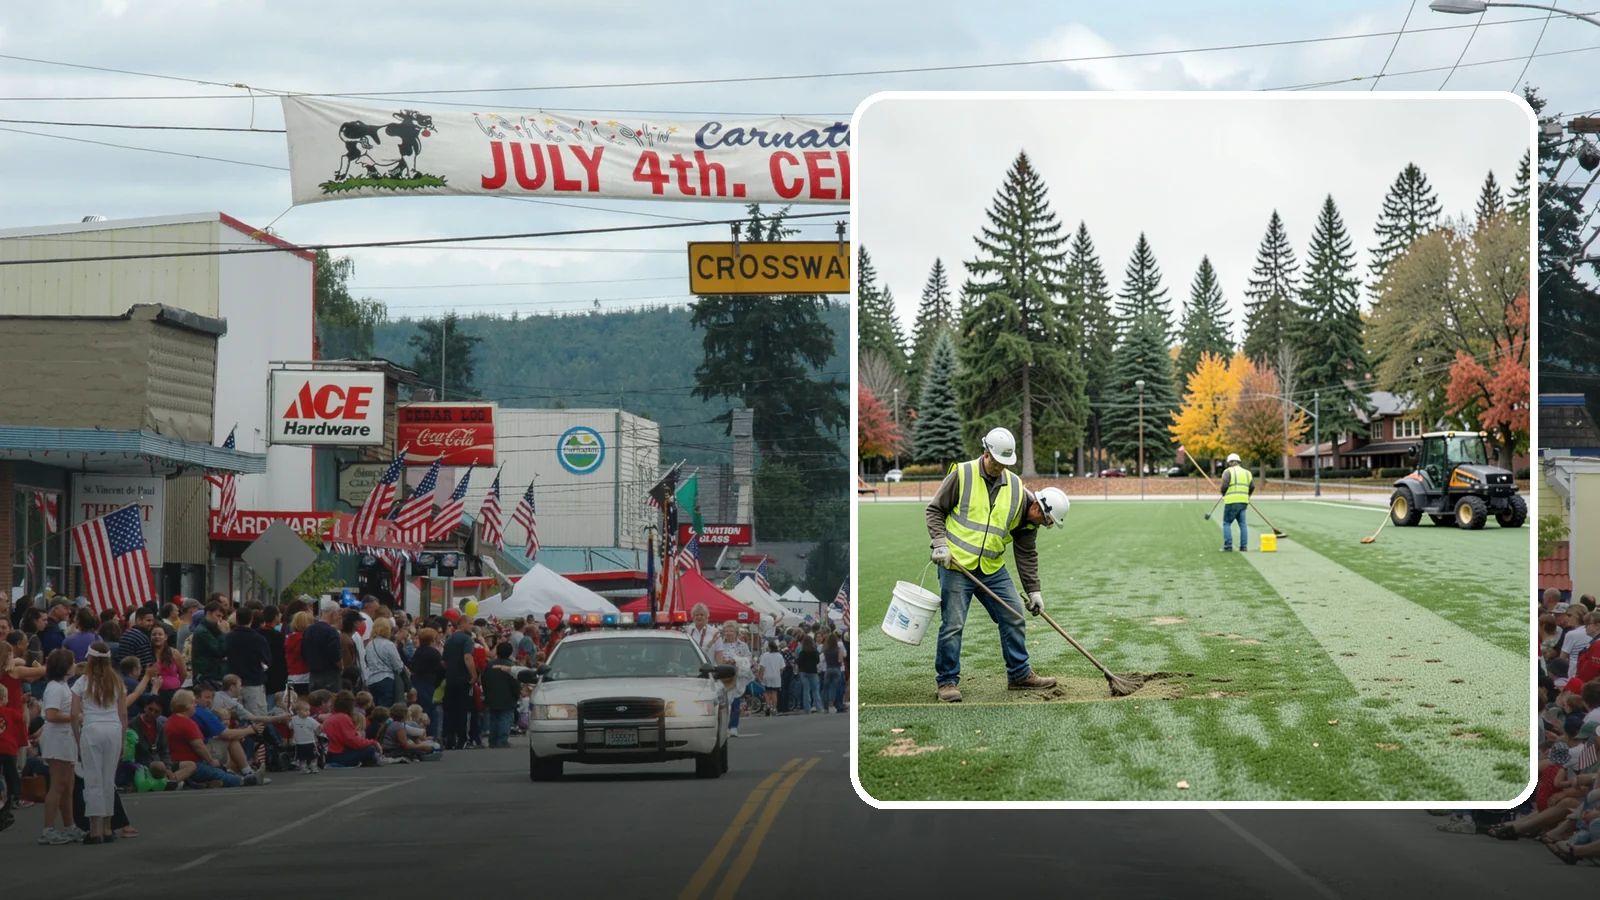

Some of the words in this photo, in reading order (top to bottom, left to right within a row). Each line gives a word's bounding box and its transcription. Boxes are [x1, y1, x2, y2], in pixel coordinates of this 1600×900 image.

[481, 141, 604, 191] JULY
[632, 150, 746, 198] 4th.
[696, 254, 850, 280] CROSSWA
[282, 379, 373, 420] ACE
[406, 409, 453, 422] CEDAR
[461, 409, 485, 422] LOG
[283, 420, 371, 437] Hardware
[416, 427, 477, 447] Coca-Cola
[83, 485, 93, 494] St.
[95, 485, 124, 494] Vincent
[126, 486, 136, 494] de
[138, 486, 155, 495] Paul
[687, 526, 741, 535] CRNATION
[699, 535, 730, 543] GLASS
